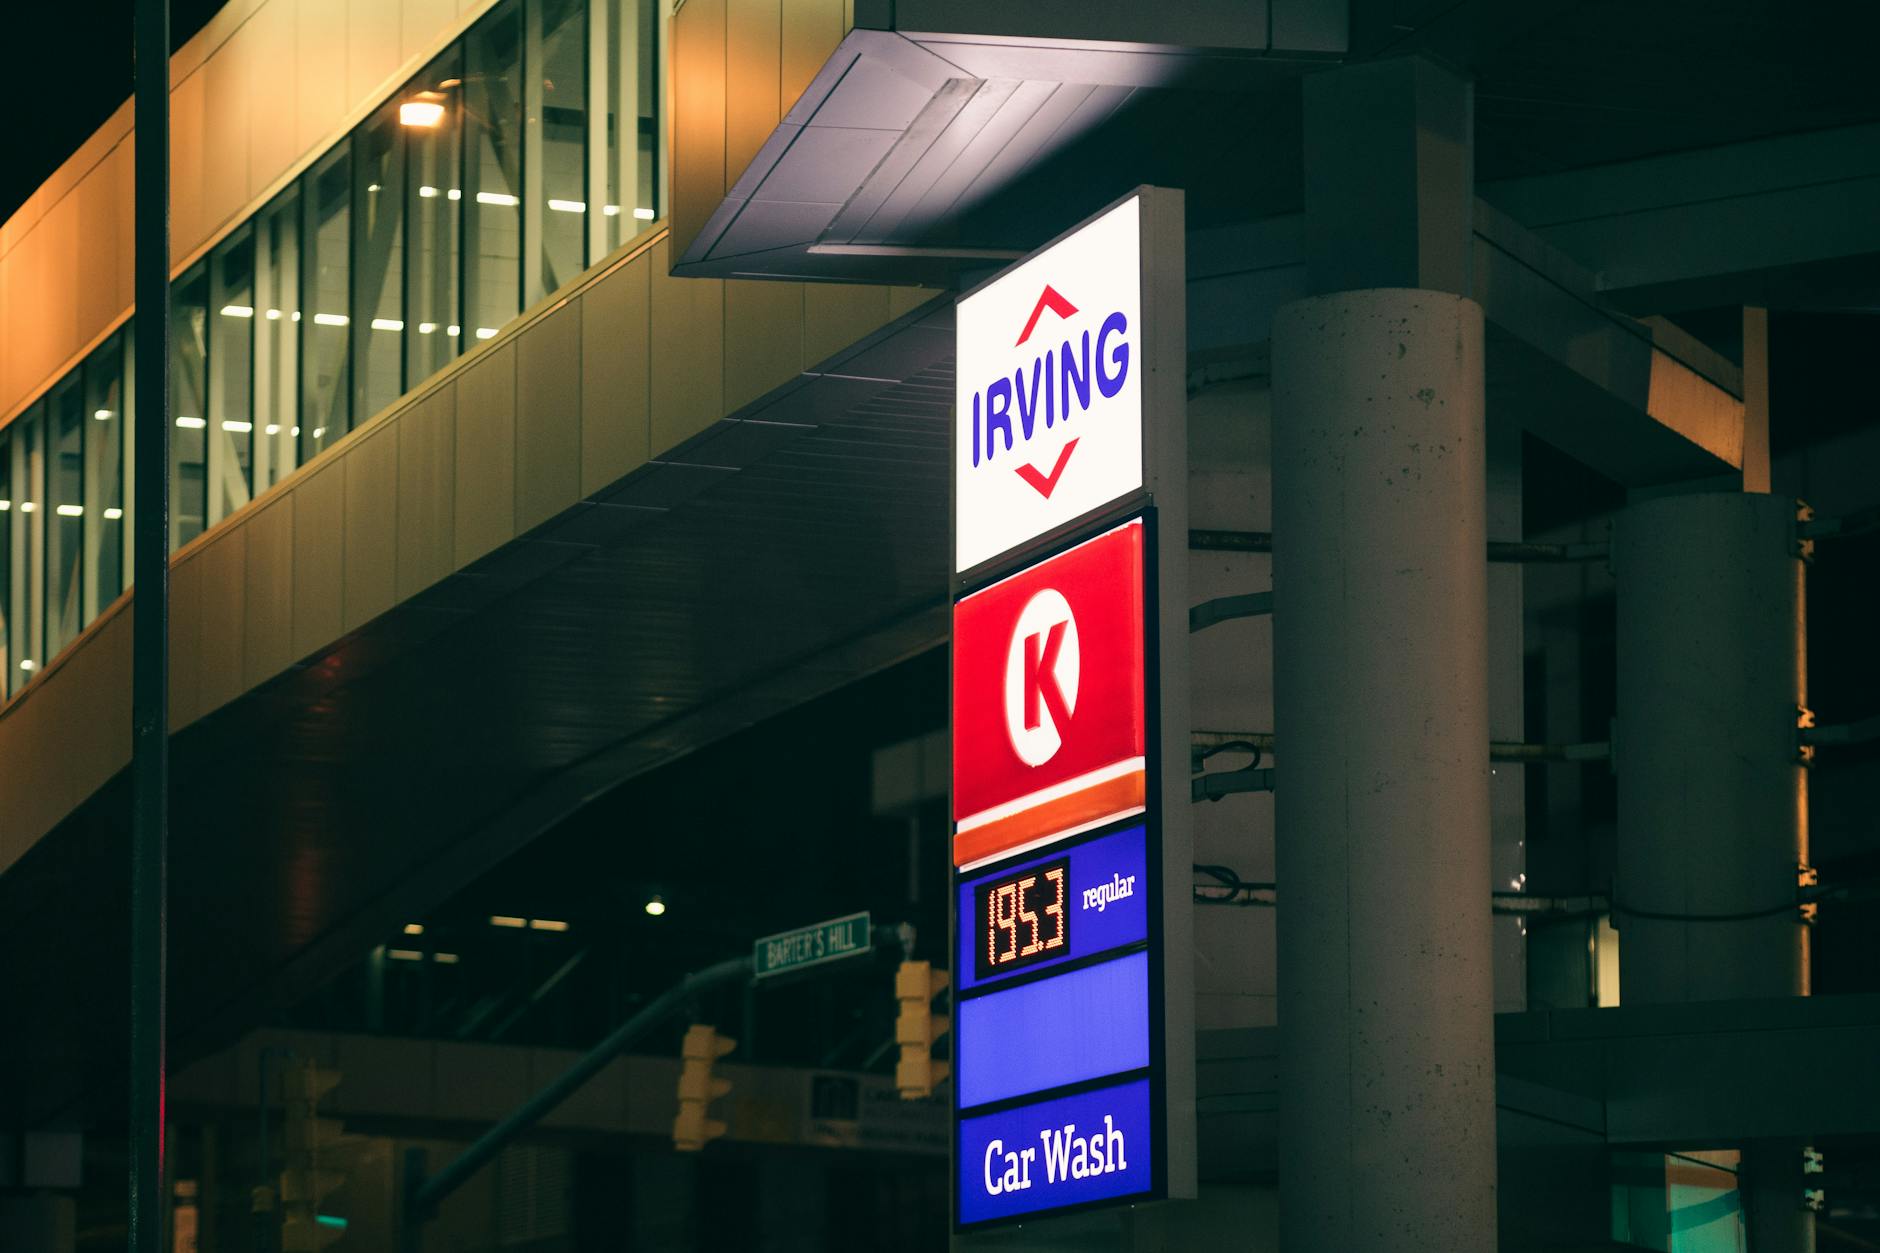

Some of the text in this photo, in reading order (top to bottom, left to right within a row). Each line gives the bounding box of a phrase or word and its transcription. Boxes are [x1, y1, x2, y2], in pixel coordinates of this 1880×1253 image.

[973, 311, 1130, 468] IRVING
[1024, 619, 1071, 738] K
[988, 867, 1064, 966] 195.3
[1082, 872, 1136, 913] regular
[767, 922, 857, 969] BARTER'S HILL
[984, 1114, 1127, 1196] Car Wash
